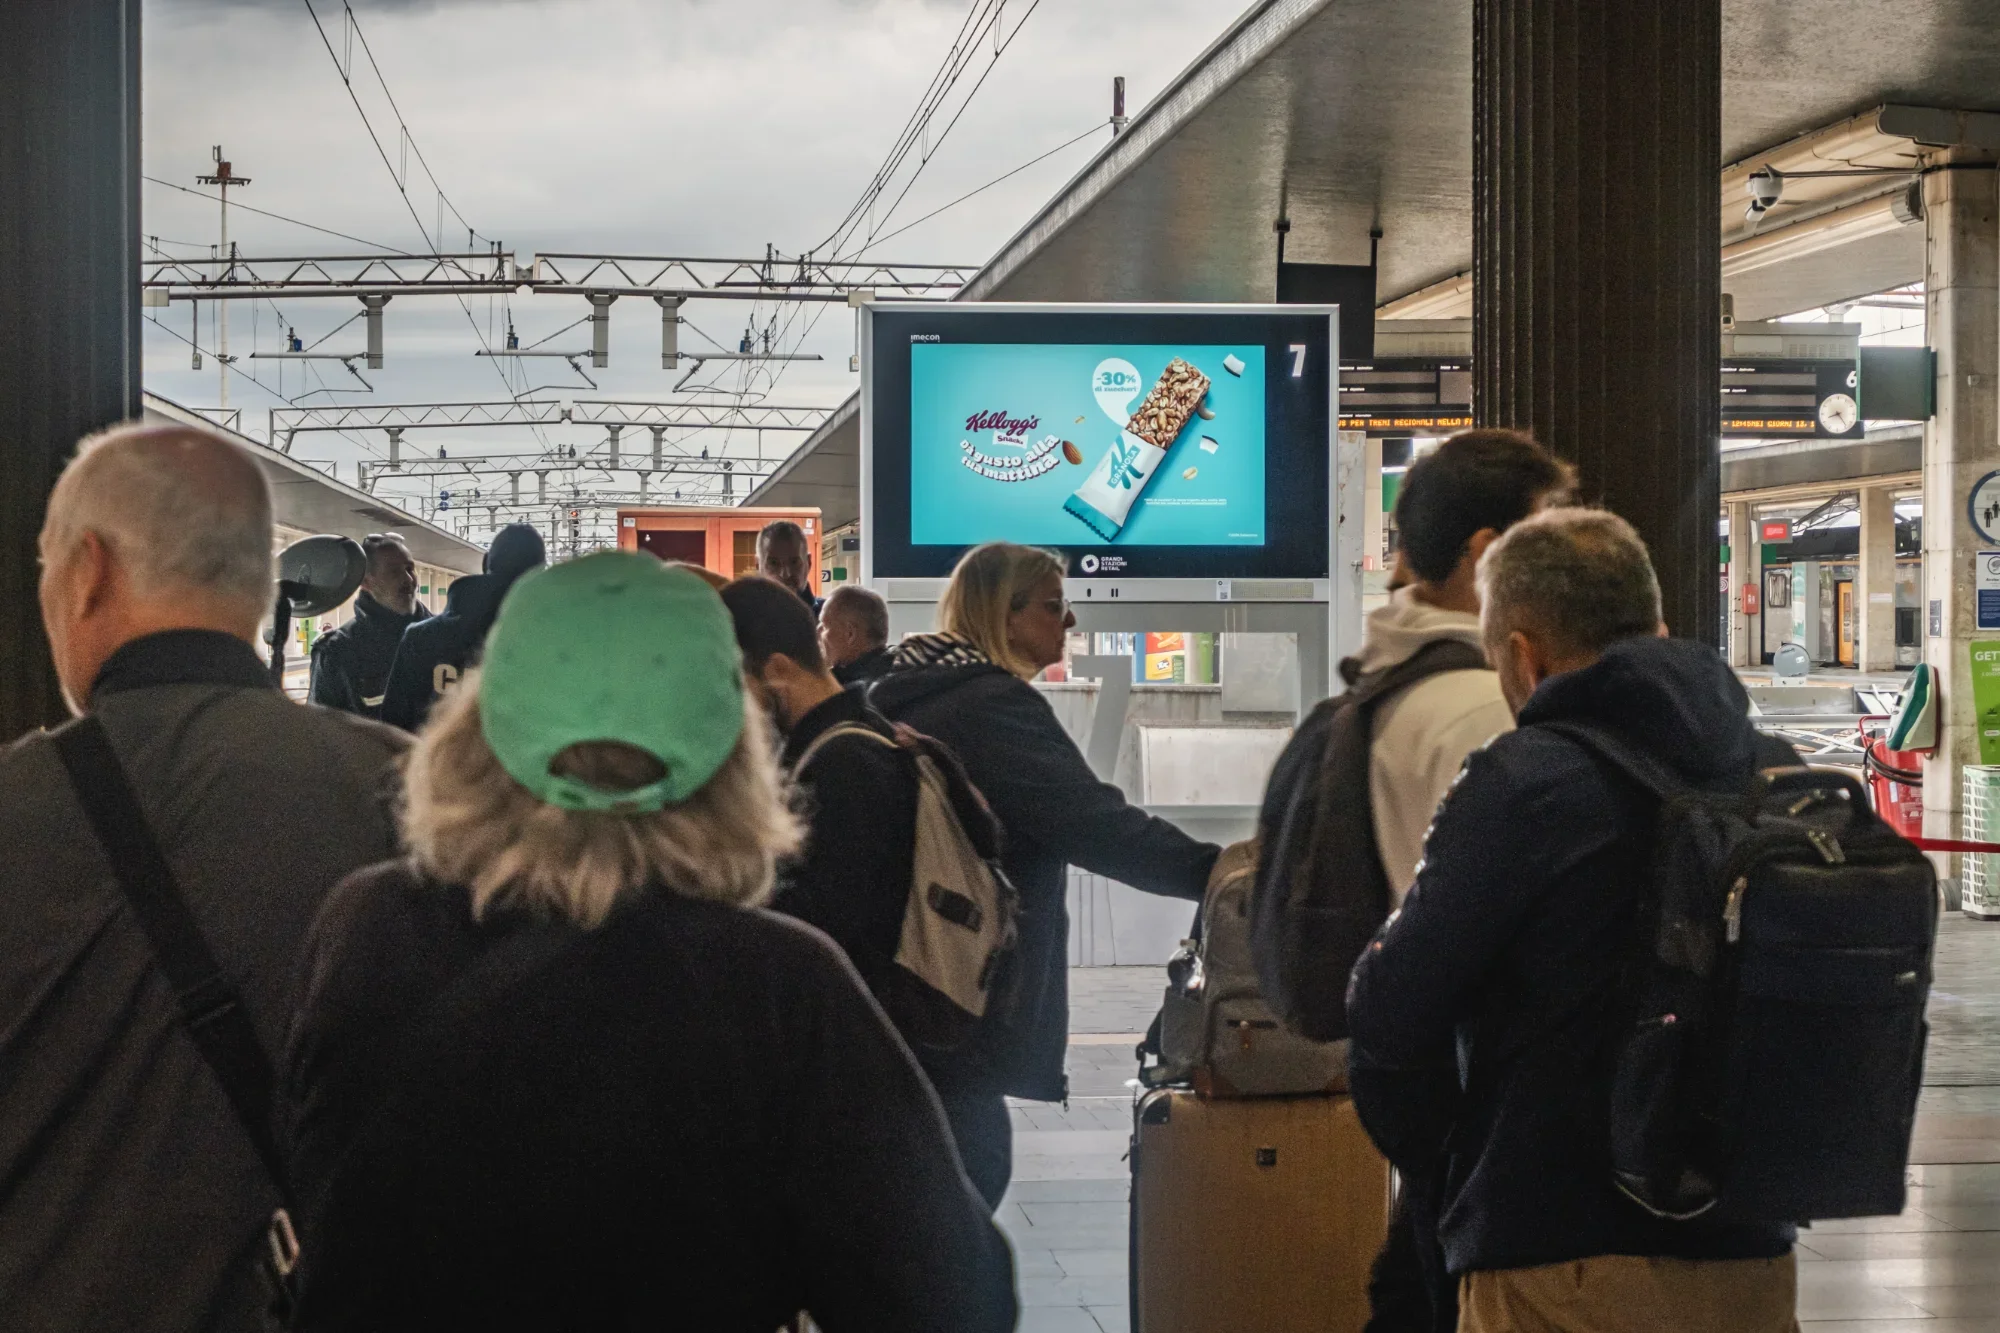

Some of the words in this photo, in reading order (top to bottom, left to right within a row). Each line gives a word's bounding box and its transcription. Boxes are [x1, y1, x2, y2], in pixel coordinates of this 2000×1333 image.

[1289, 344, 1306, 378] 7
[1096, 371, 1137, 386] -30%
[1846, 370, 1857, 388] 6
[965, 409, 1042, 436] Kellogg's
[1369, 418, 1391, 427] TRENI
[1394, 418, 1434, 427] REGIONALI
[1437, 417, 1461, 426] NELLA
[973, 451, 1023, 468] gusto
[1025, 434, 1061, 463] alla
[961, 456, 984, 476] tua
[983, 453, 1060, 482] mattina
[1110, 449, 1138, 484] GRANOLA
